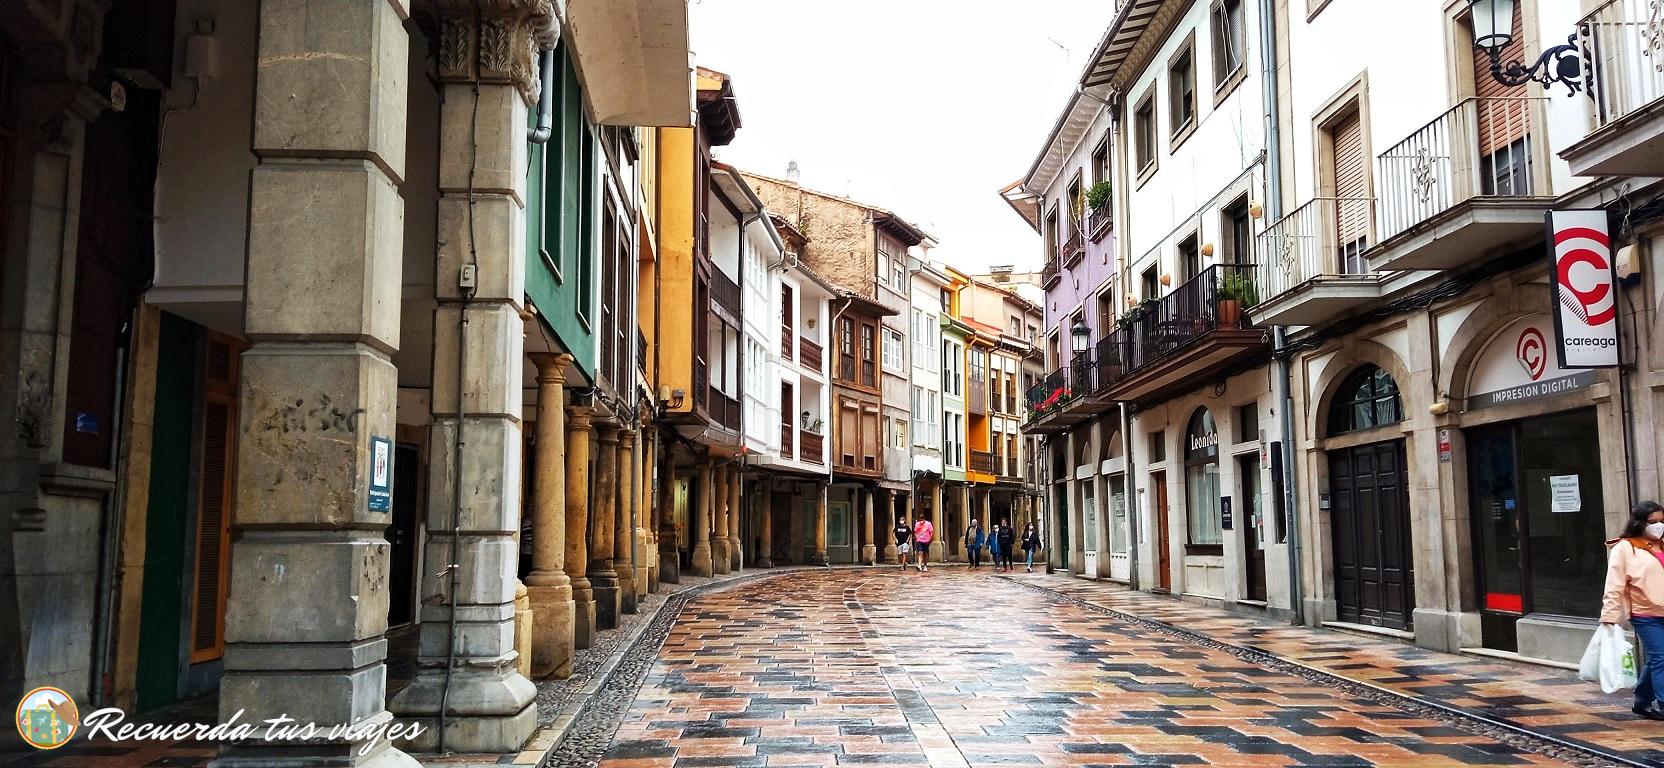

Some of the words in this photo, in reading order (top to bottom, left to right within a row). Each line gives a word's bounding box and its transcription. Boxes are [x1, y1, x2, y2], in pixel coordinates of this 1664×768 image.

[1565, 337, 1616, 349] careaga
[1492, 386, 1539, 403] IMPRESION
[1541, 377, 1579, 395] DIGITAL
